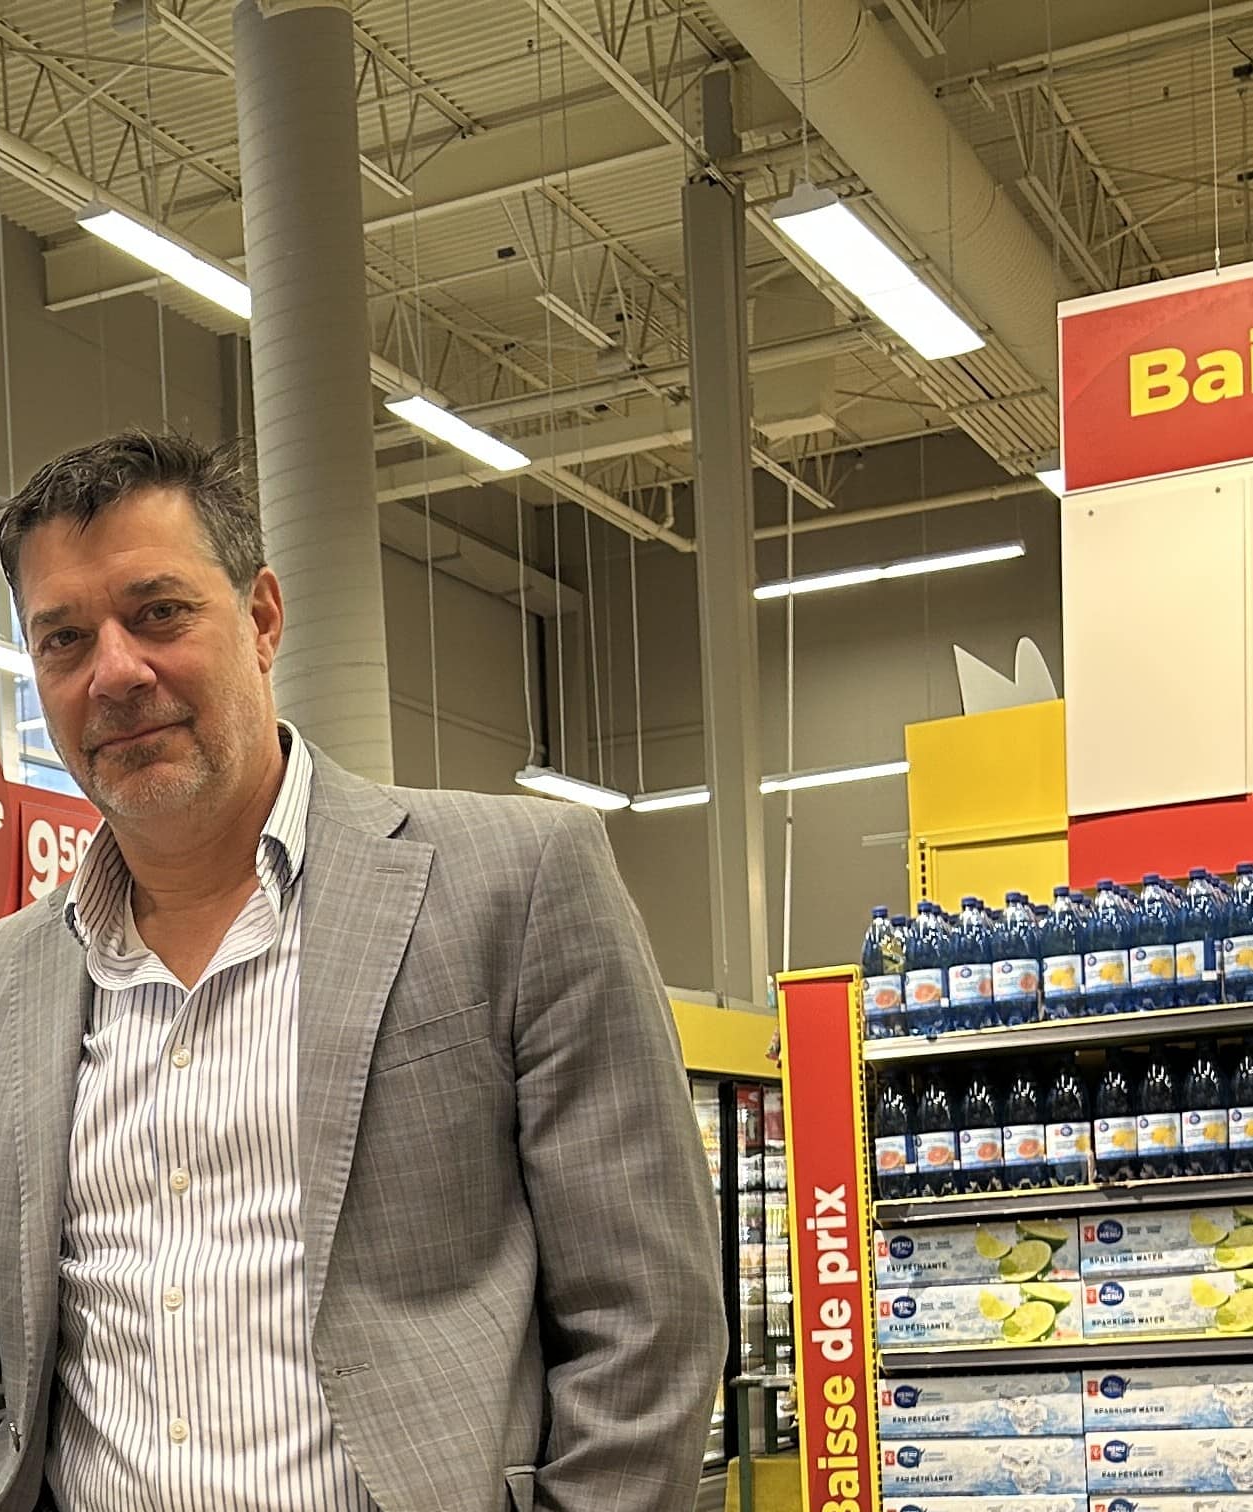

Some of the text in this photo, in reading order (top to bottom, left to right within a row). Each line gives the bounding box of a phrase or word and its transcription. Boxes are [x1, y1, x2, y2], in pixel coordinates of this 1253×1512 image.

[1130, 348, 1253, 417] Ba
[806, 1183, 858, 1285] prix
[1136, 1253, 1164, 1262] WATER
[811, 1297, 853, 1362] de
